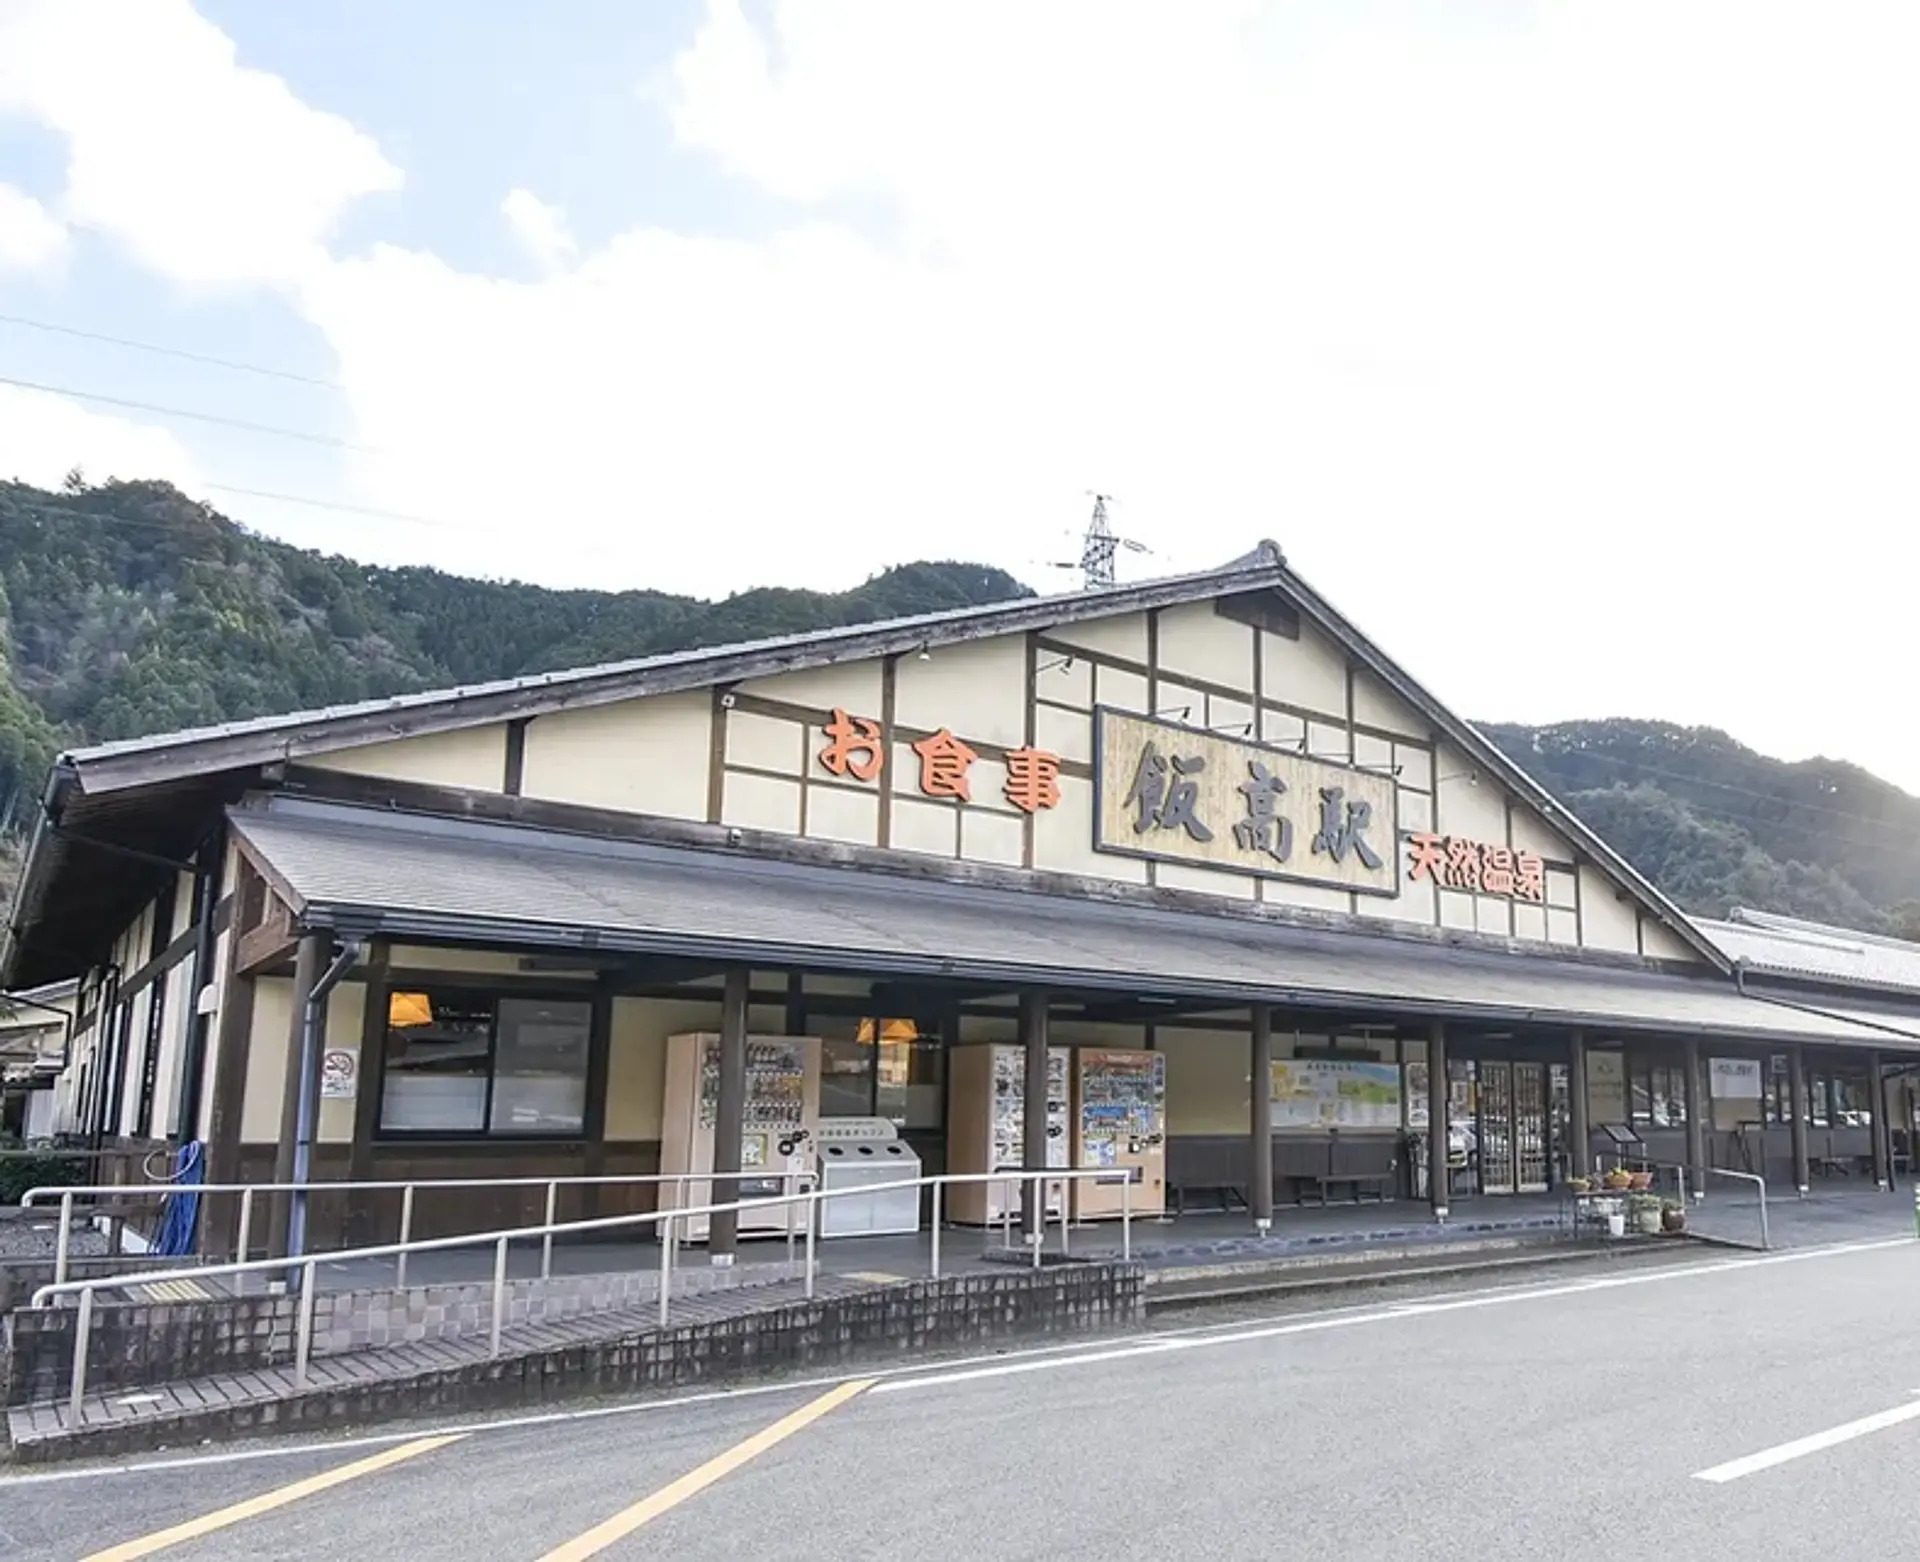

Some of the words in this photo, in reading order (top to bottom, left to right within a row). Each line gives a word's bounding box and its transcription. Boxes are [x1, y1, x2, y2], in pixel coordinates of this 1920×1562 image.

[819, 707, 1061, 813] お食事
[1123, 740, 1383, 870] 飯高駅
[1407, 833, 1544, 902] 天然温泉
